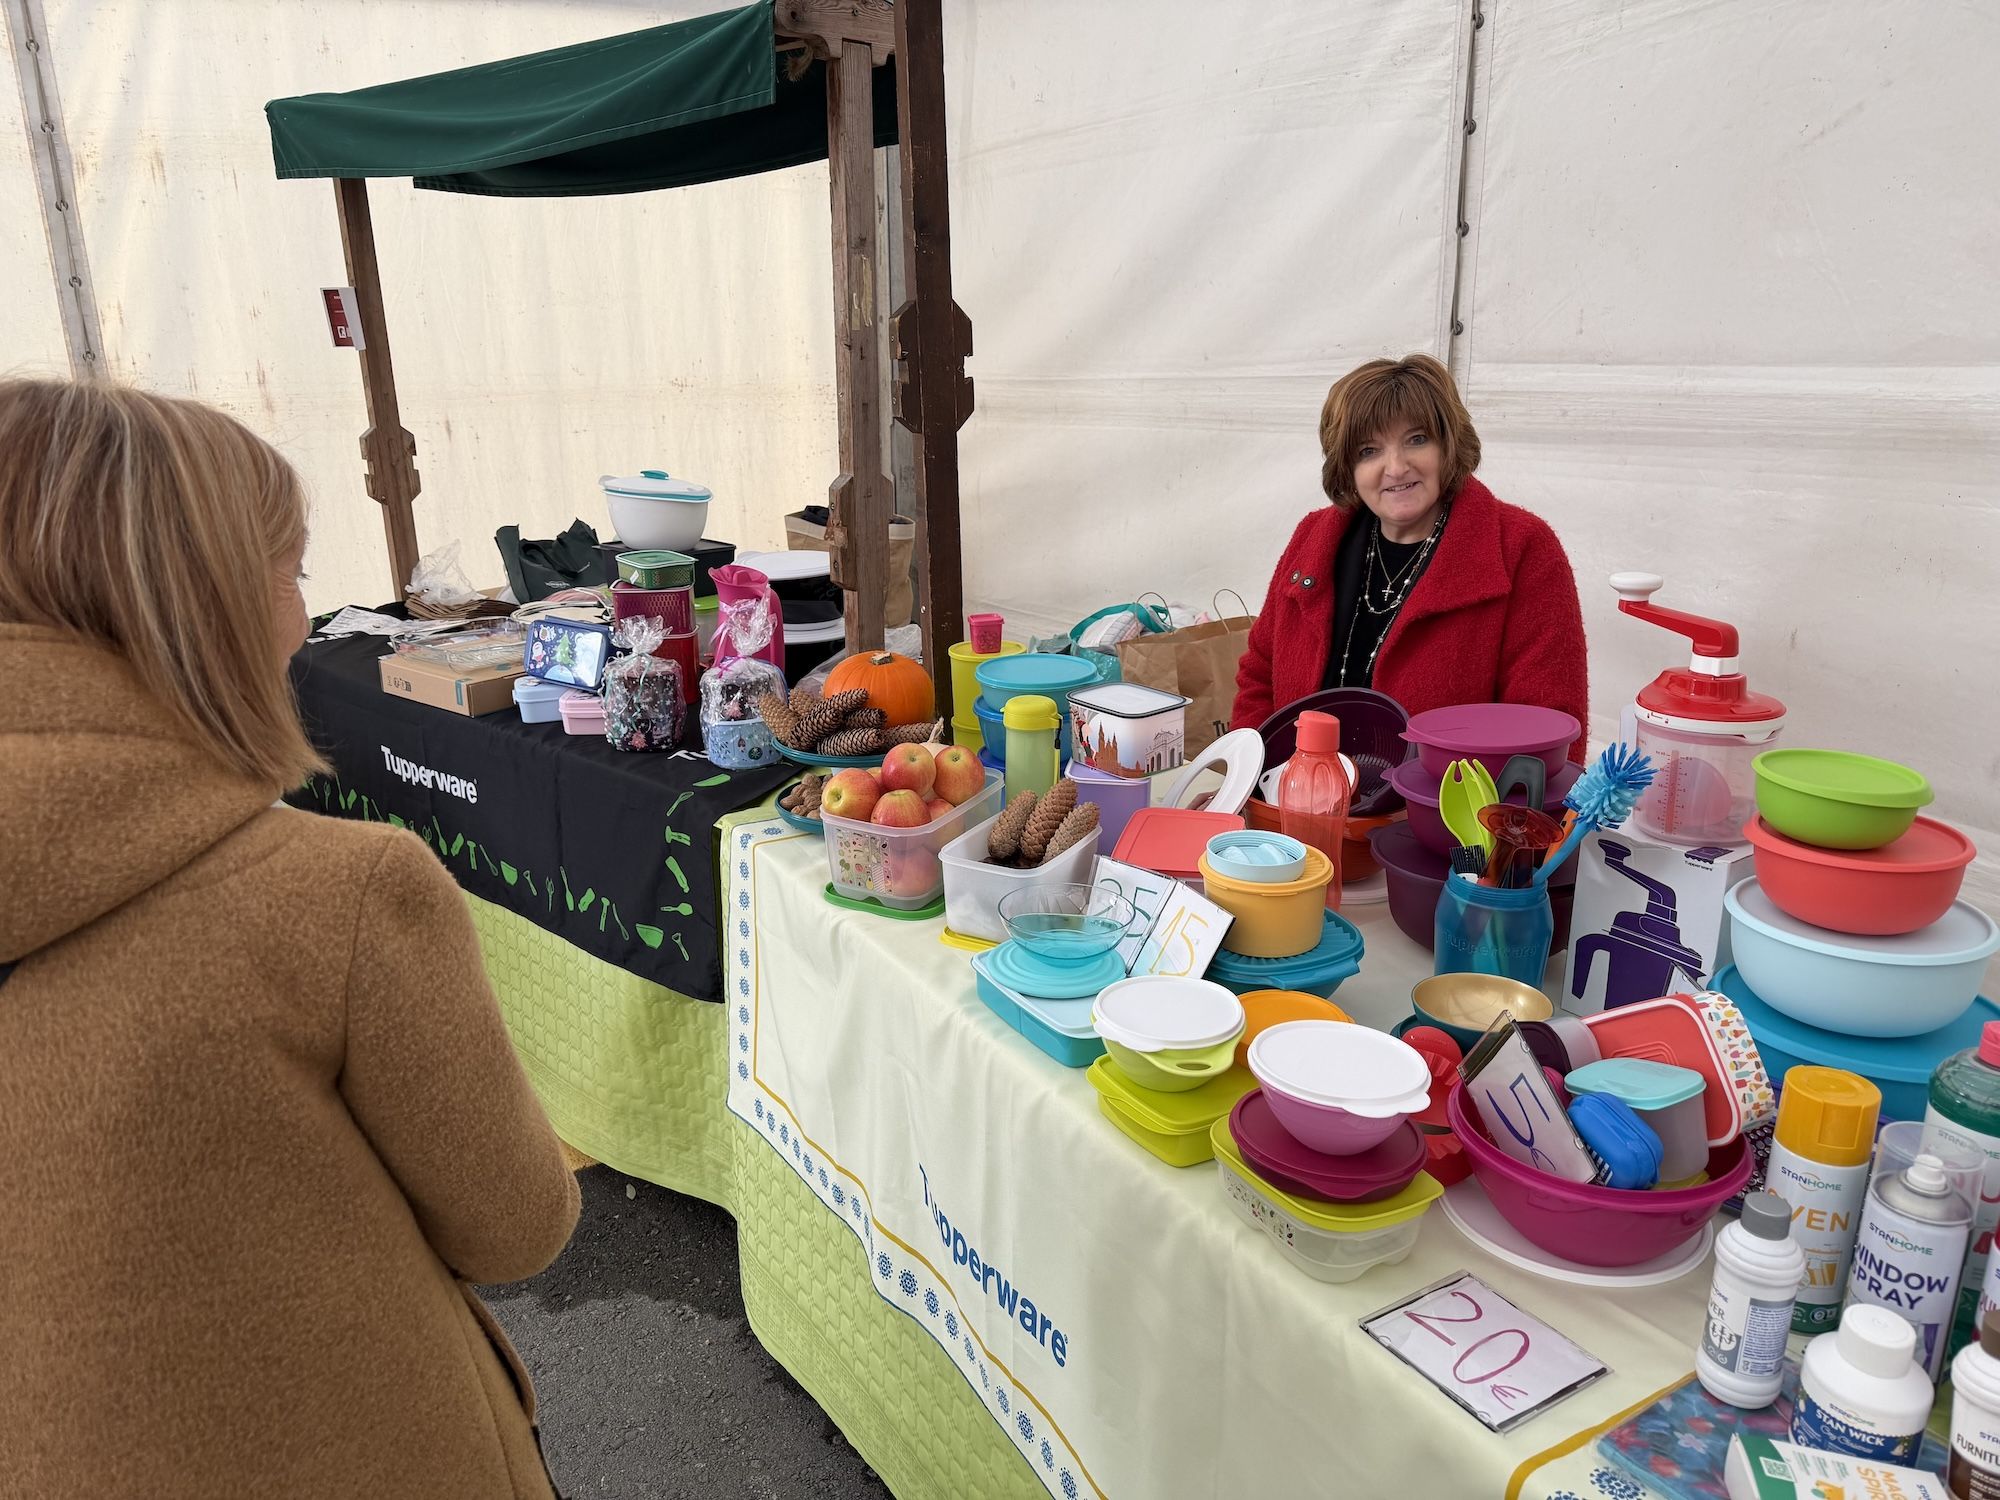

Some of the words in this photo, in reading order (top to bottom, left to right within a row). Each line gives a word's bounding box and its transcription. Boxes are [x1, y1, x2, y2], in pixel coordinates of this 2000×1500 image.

[380, 744, 478, 804] Tupperware
[1148, 905, 1209, 977] 15
[1781, 1166, 1842, 1191] STANHOME
[1868, 1222, 1934, 1256] STANHOME
[919, 1162, 1068, 1368] Tupperware
[1815, 1408, 1846, 1433] STAN
[1848, 1427, 1886, 1447] WICK
